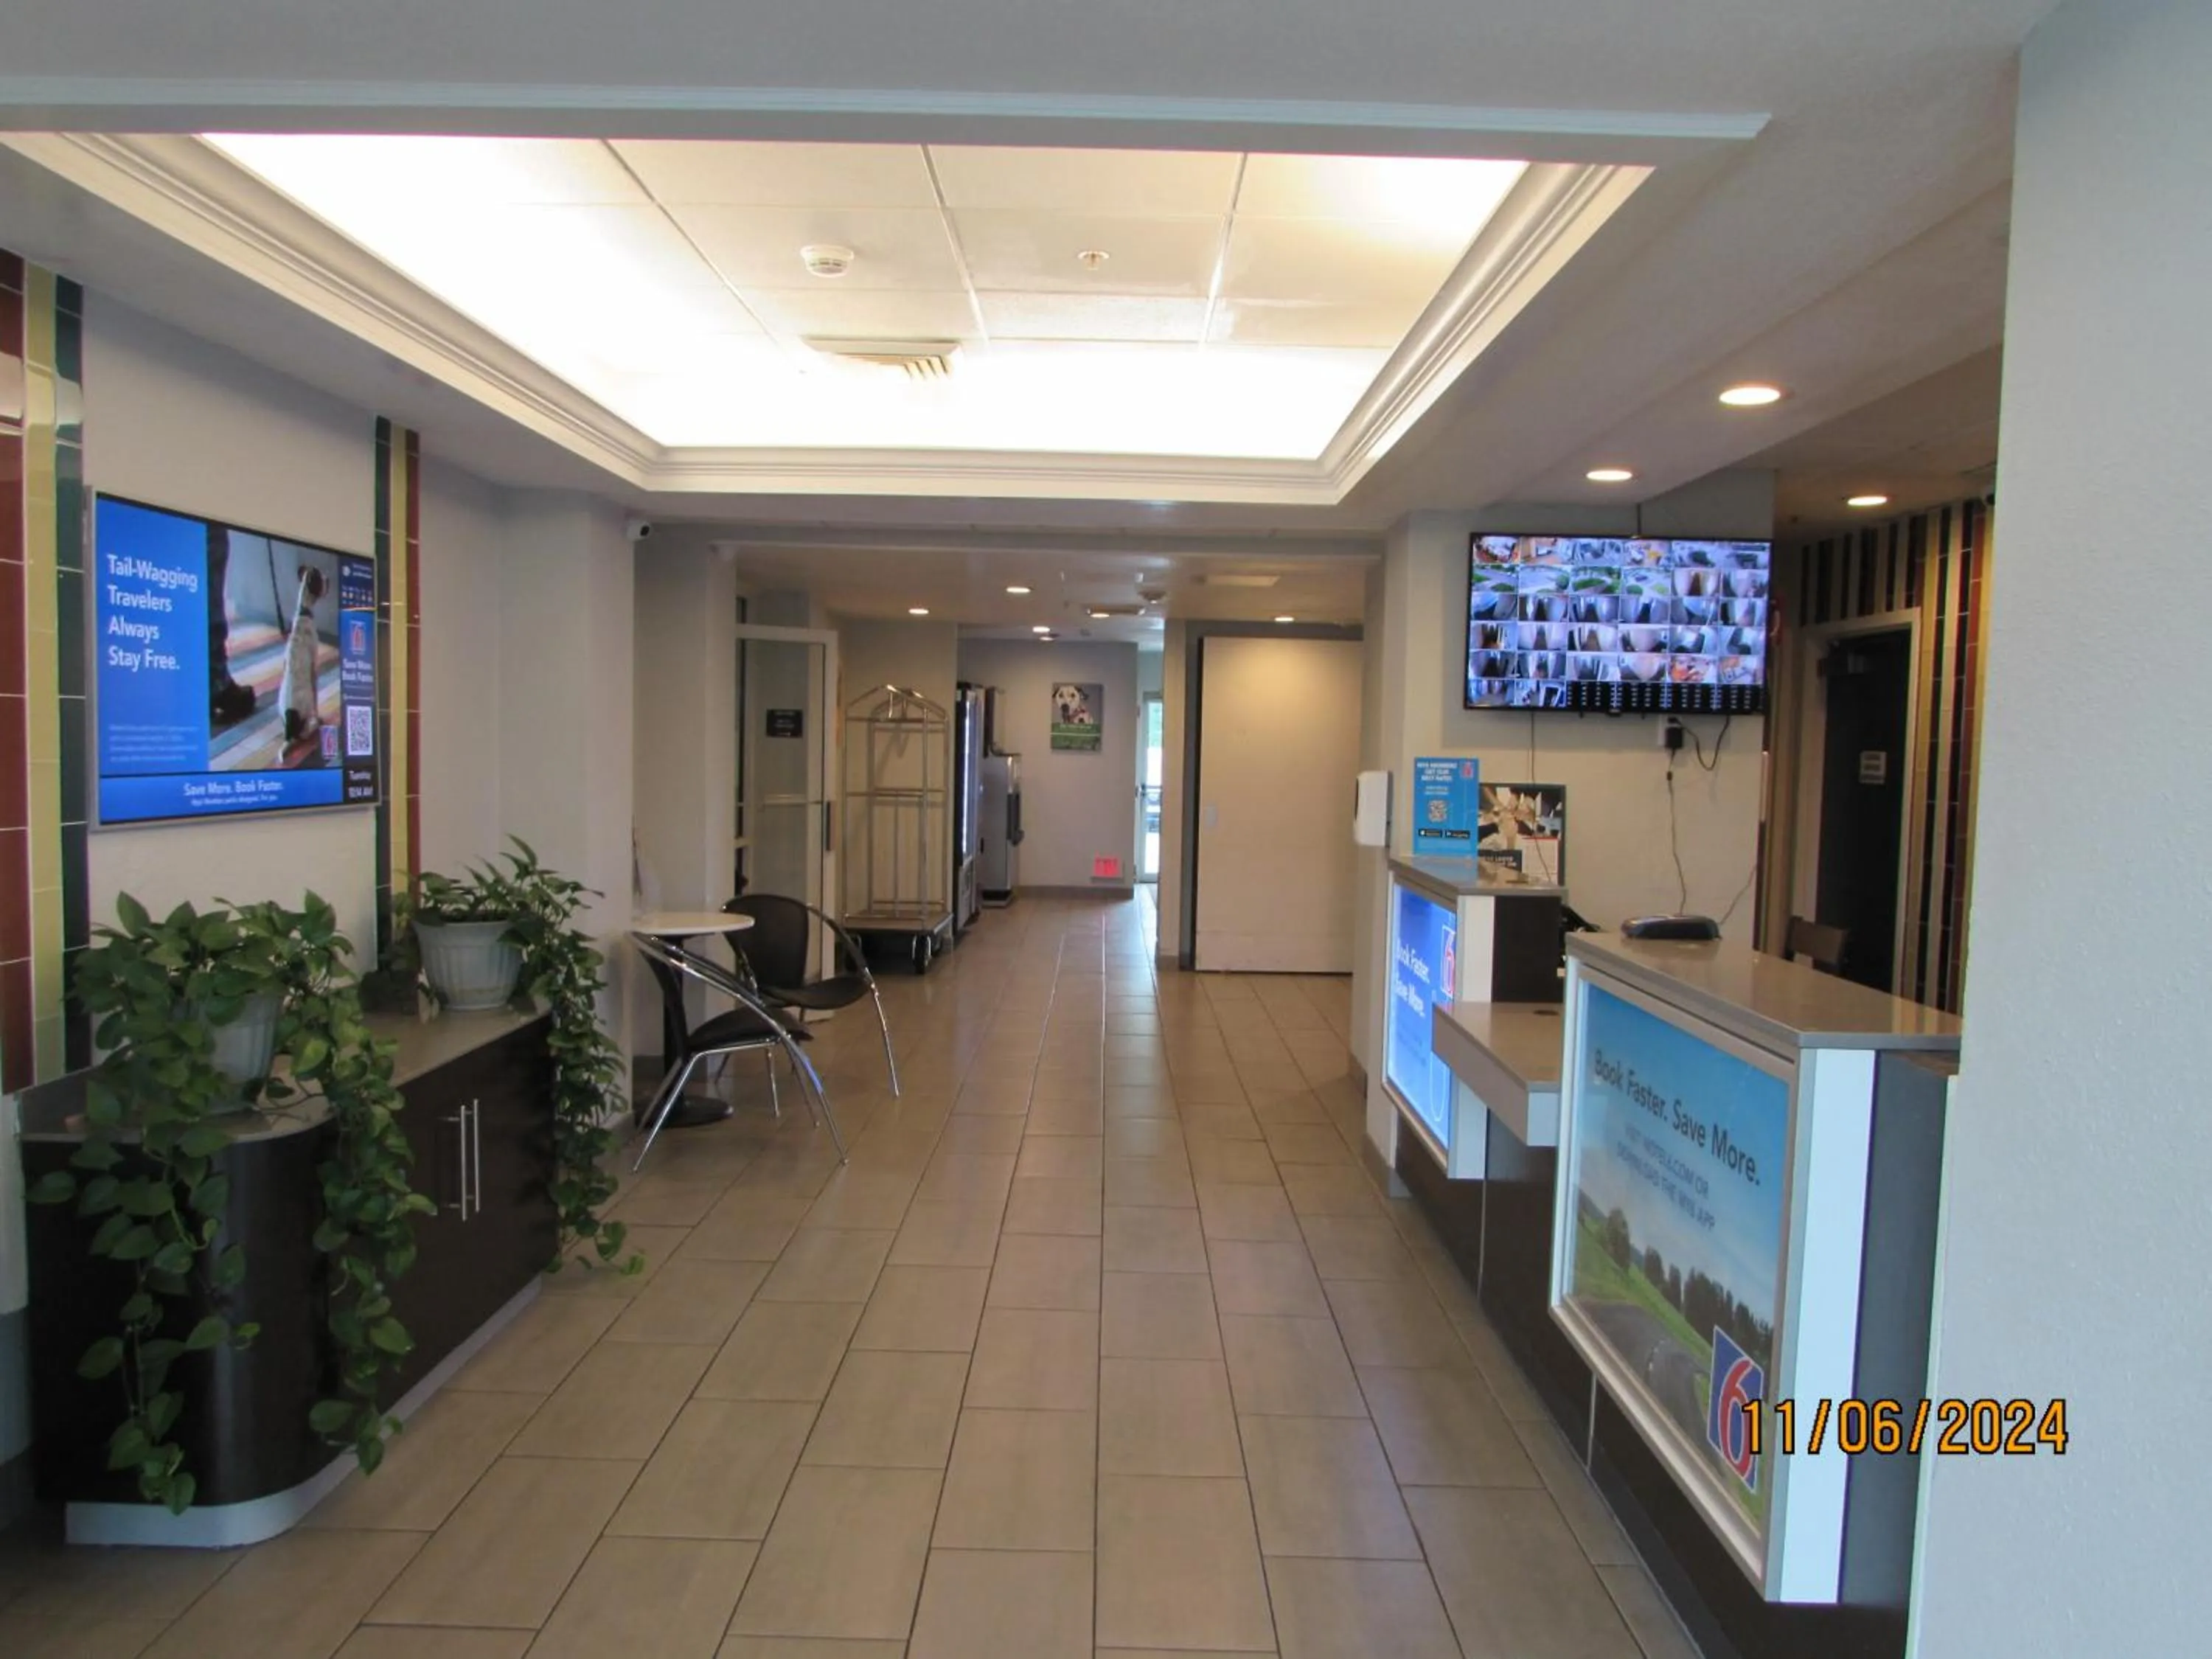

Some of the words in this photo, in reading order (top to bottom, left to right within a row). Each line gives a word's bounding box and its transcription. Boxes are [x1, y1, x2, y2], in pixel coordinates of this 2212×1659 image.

[107, 554, 198, 593] Tail-Wagging
[107, 584, 173, 612] Travelers
[108, 614, 159, 651] Always
[108, 645, 141, 672] Stay
[145, 648, 180, 669] Free.
[257, 779, 283, 792] Fat.
[1594, 1048, 1624, 1090] Book
[1627, 1068, 1668, 1122] Faster.
[1673, 1098, 1706, 1148] Save
[1712, 1123, 1761, 1186] More.
[1718, 1357, 1753, 1479] 6
